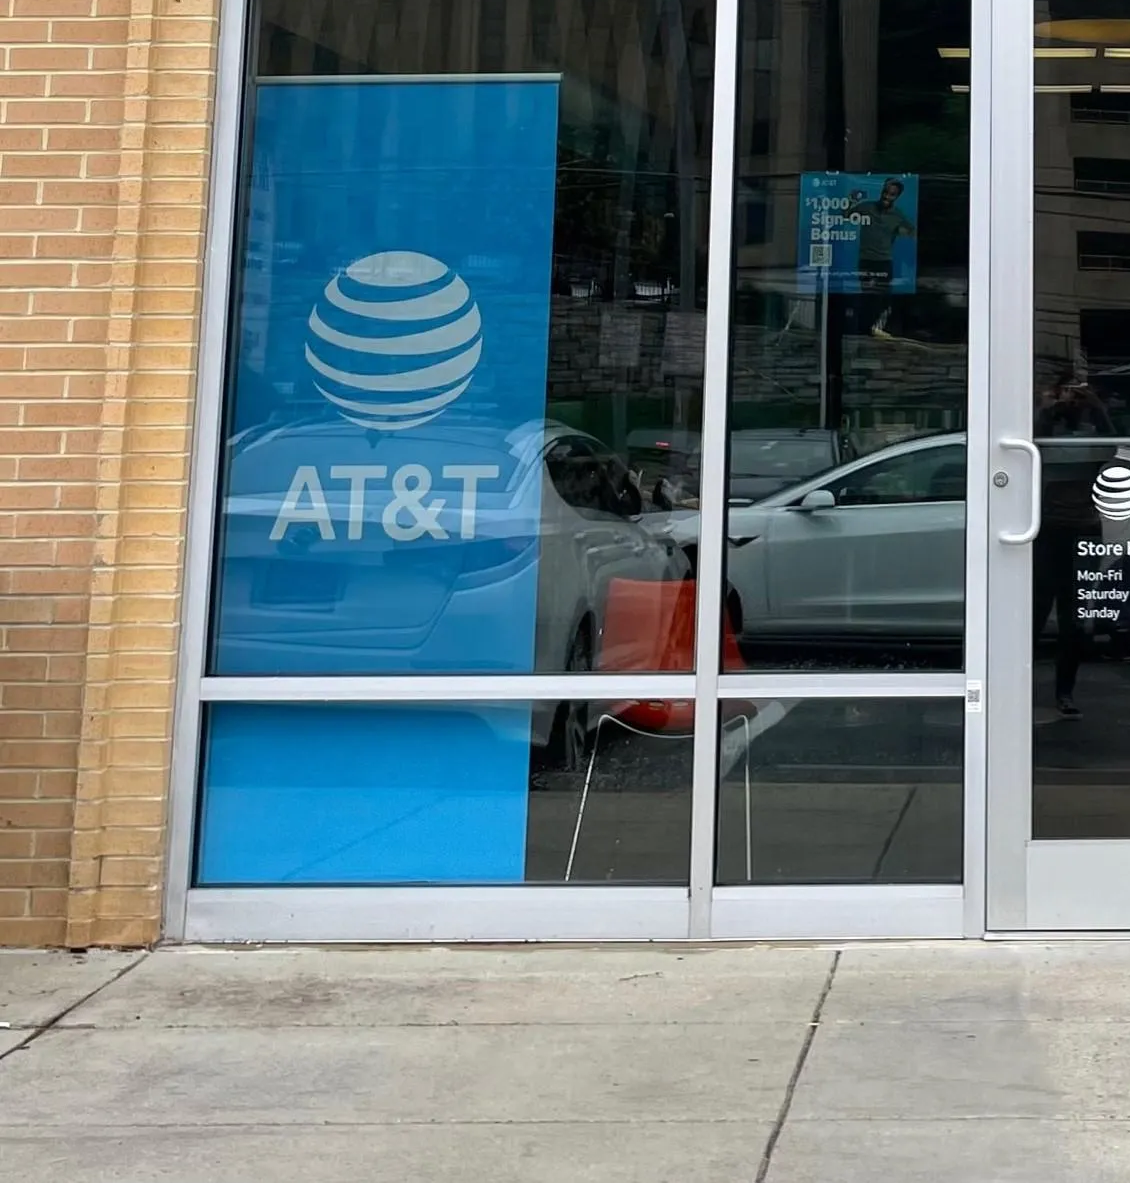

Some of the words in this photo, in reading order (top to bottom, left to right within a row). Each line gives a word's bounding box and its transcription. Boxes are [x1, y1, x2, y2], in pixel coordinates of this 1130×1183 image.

[806, 197, 850, 212] $1,000
[811, 211, 871, 229] Sign-On
[811, 228, 857, 241] Bonus
[269, 464, 499, 541] AT&T
[1077, 541, 1123, 556] Store
[1077, 570, 1123, 581] Mon-Fri
[1077, 589, 1129, 602] Saturday
[1077, 607, 1120, 620] Sunday
